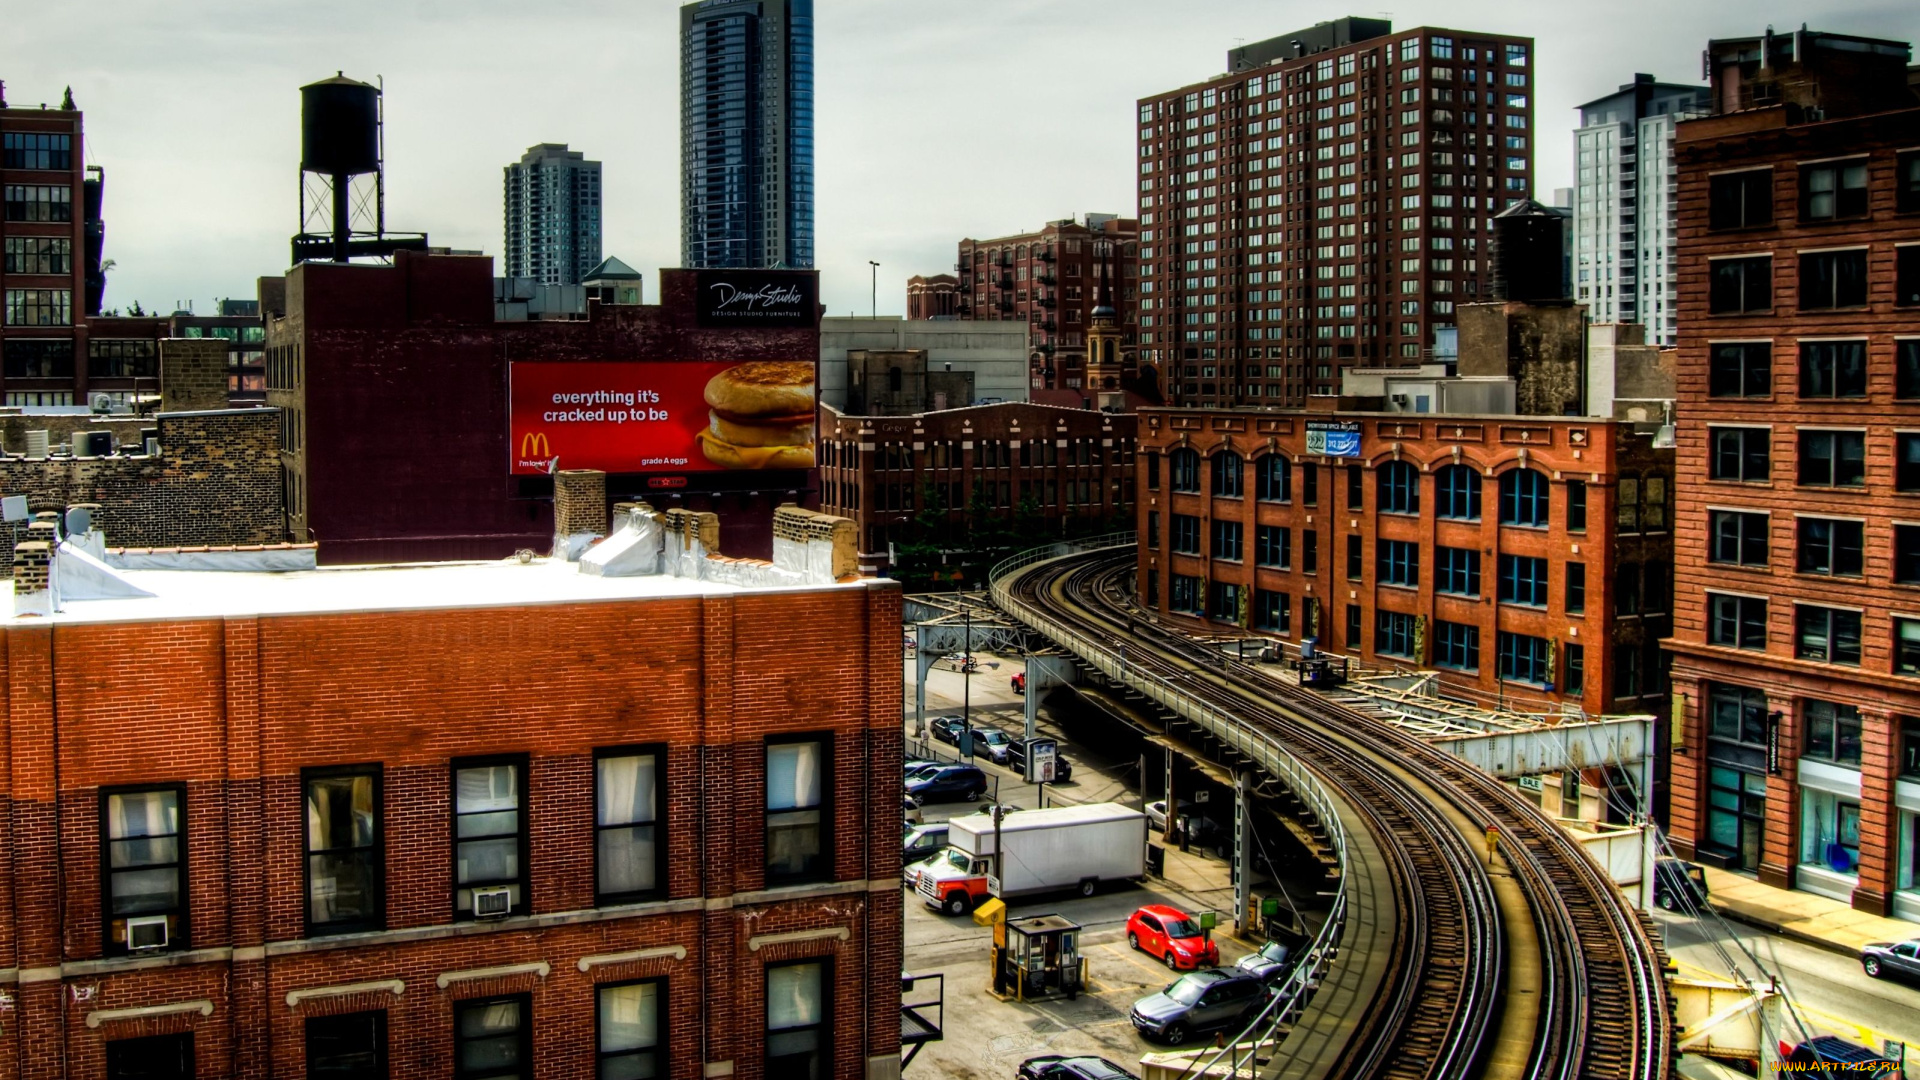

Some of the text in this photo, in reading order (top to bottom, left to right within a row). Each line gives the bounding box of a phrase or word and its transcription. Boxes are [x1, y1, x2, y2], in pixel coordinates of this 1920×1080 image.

[552, 390, 660, 406] everything it's
[543, 407, 669, 424] cracked up to be
[1308, 435, 1325, 450] 222
[641, 457, 663, 466] grade
[670, 458, 688, 466] eggs
